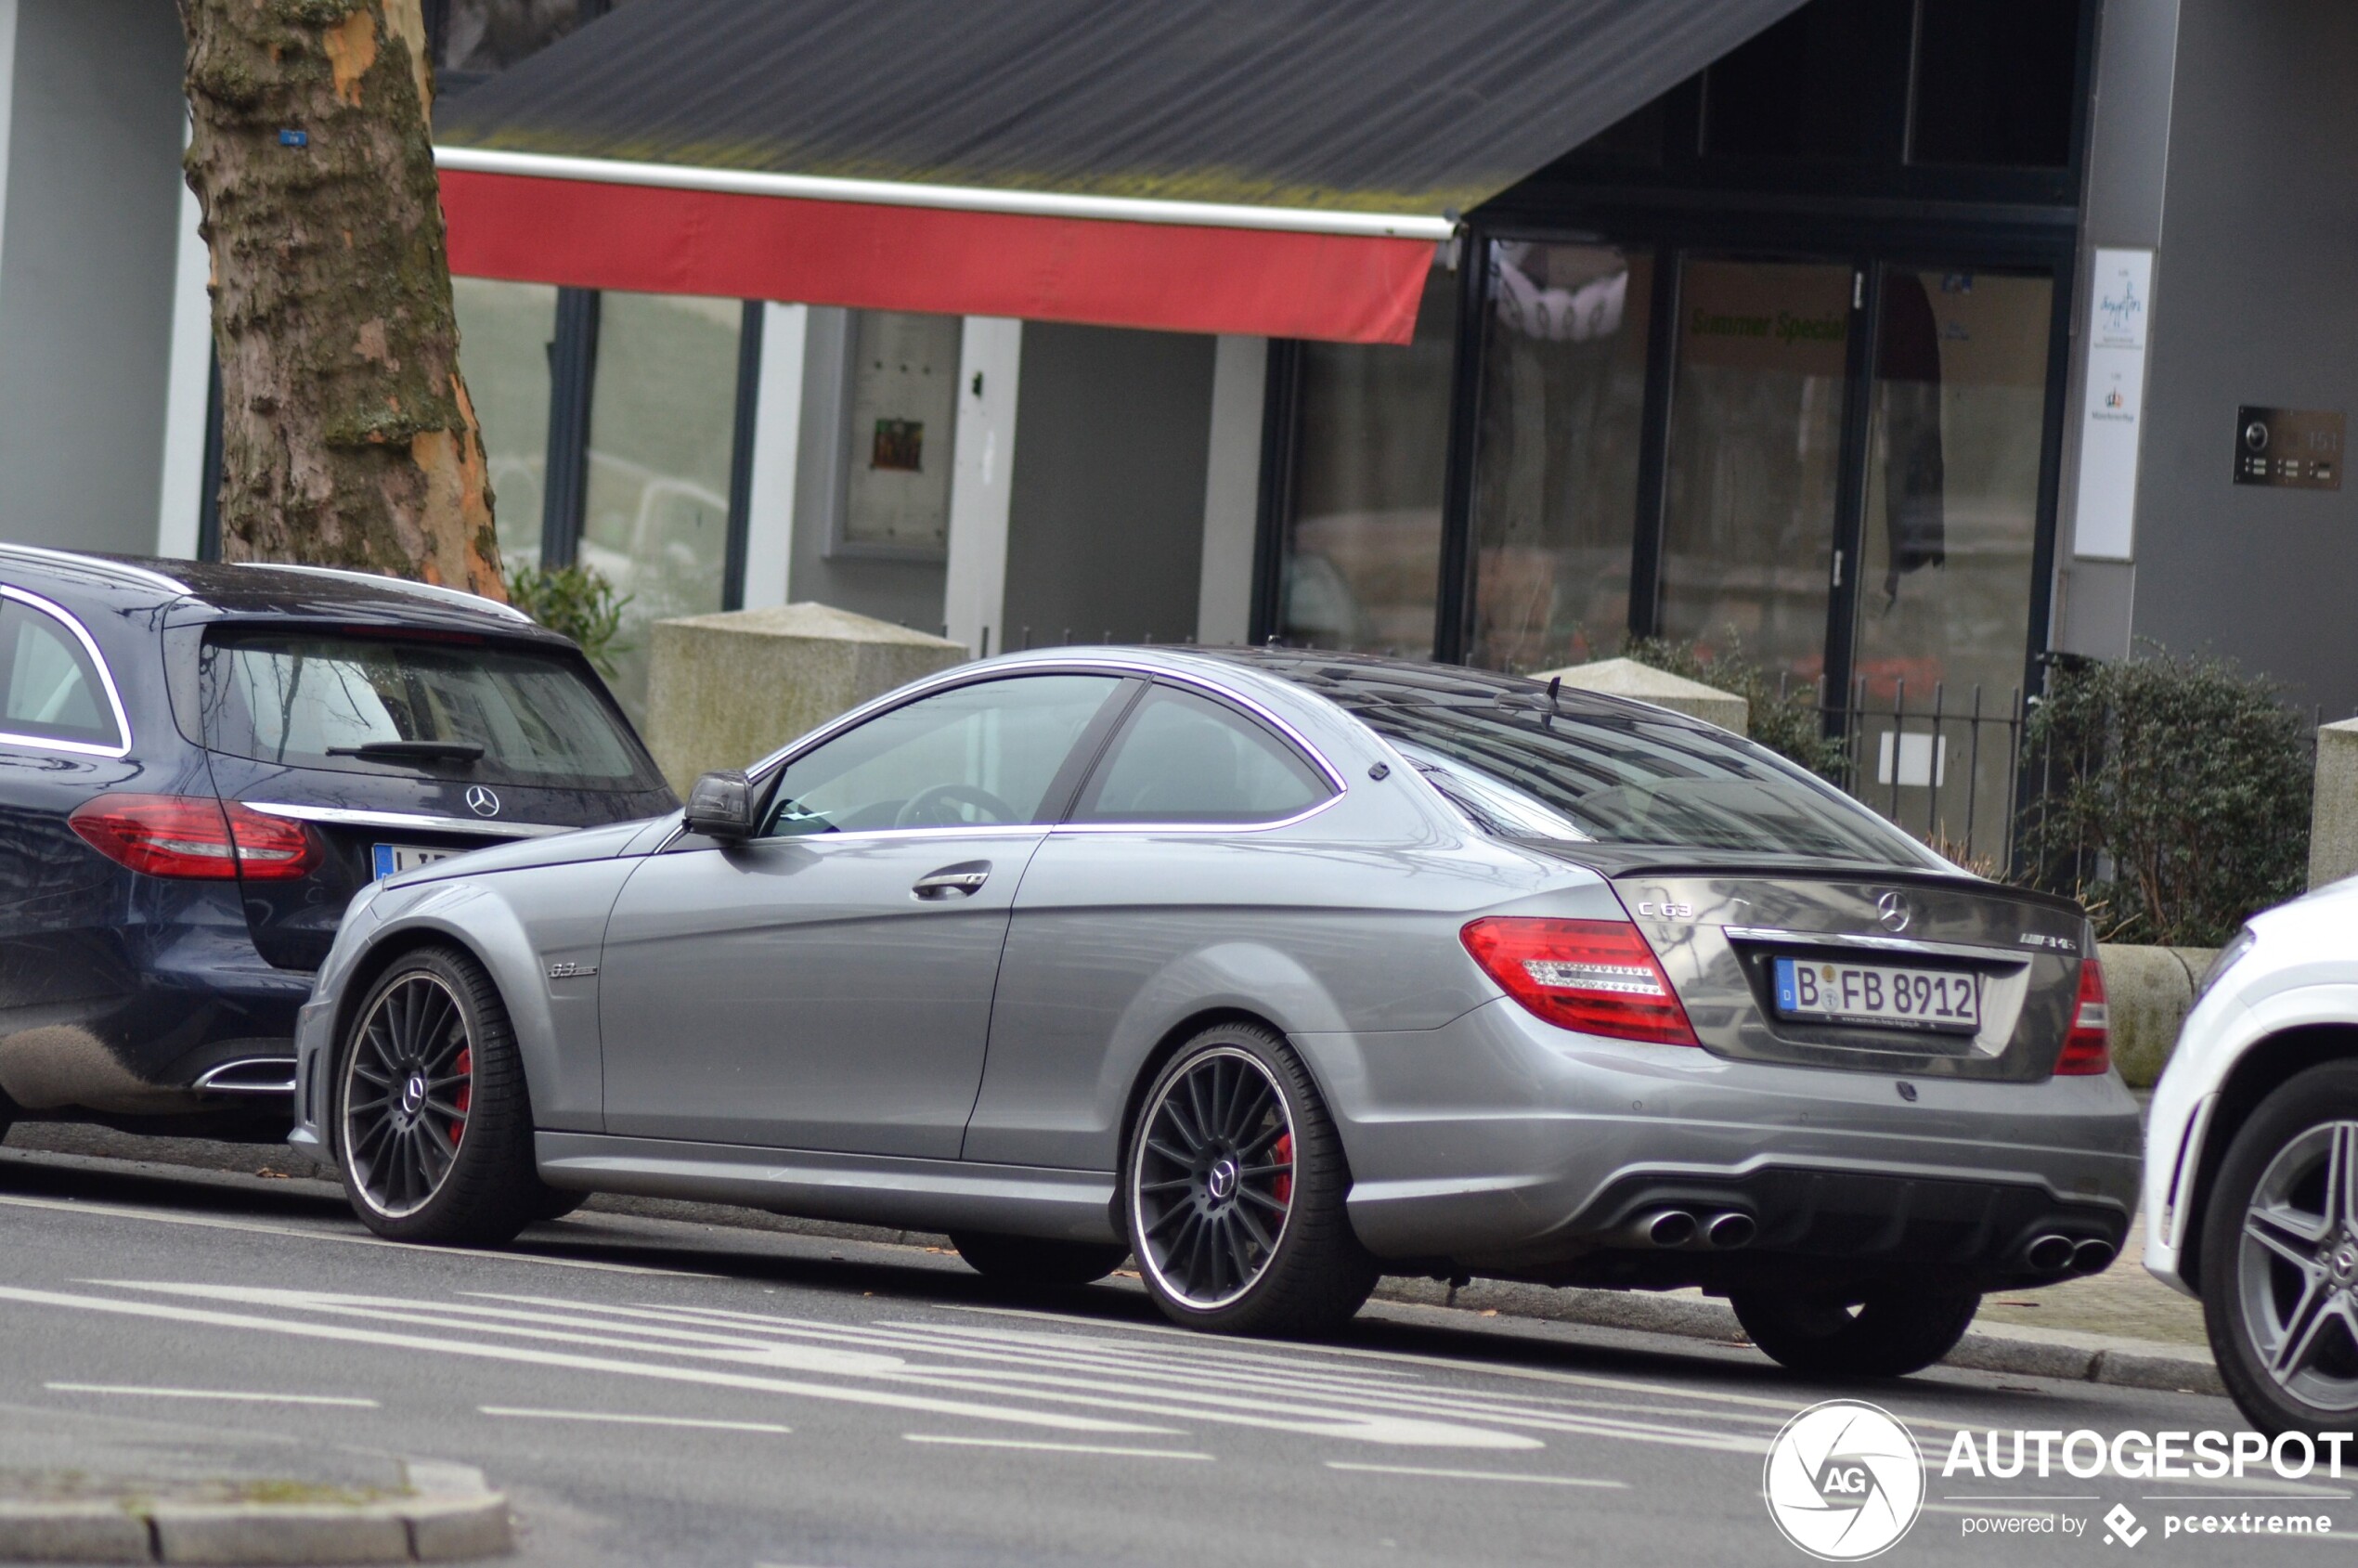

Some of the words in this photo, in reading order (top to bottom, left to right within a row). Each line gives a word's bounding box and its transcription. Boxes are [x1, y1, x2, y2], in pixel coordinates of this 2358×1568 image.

[1691, 306, 1771, 336] Summer
[1774, 308, 1847, 344] Special
[1639, 902, 1653, 915] C
[1661, 902, 1692, 917] 63
[1783, 989, 1792, 1001] D
[1797, 966, 1820, 1006] B
[1841, 970, 1885, 1011] FB
[1893, 973, 1974, 1018] 8912
